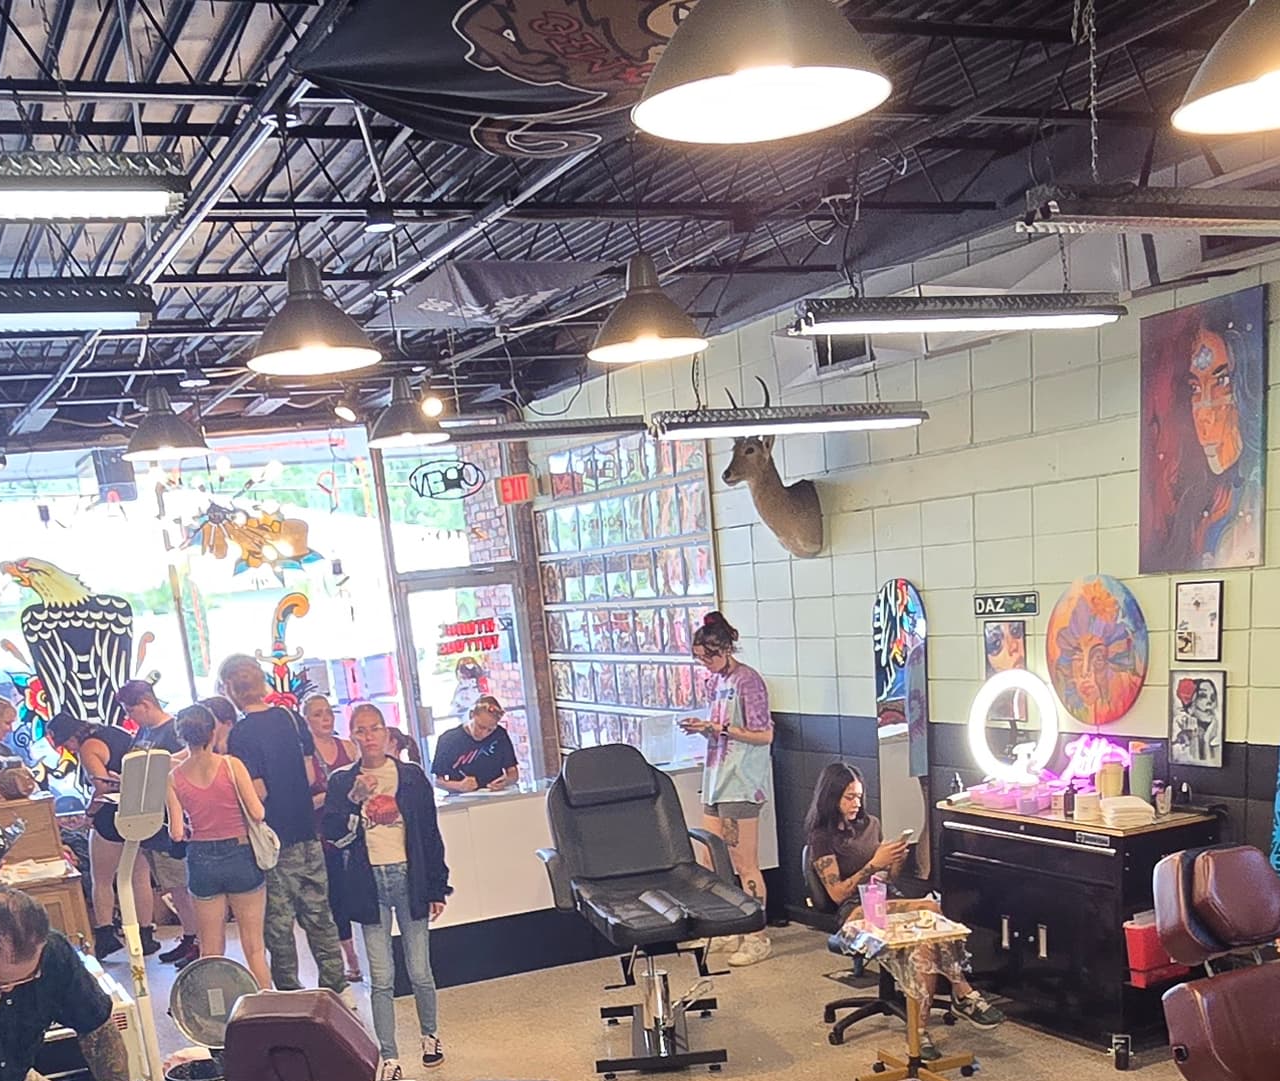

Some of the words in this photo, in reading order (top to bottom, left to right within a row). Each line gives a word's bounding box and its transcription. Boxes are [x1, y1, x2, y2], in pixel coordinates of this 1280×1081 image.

[500, 475, 529, 503] EXIT
[976, 598, 1005, 613] DAZ
[452, 740, 499, 769] NIKE
